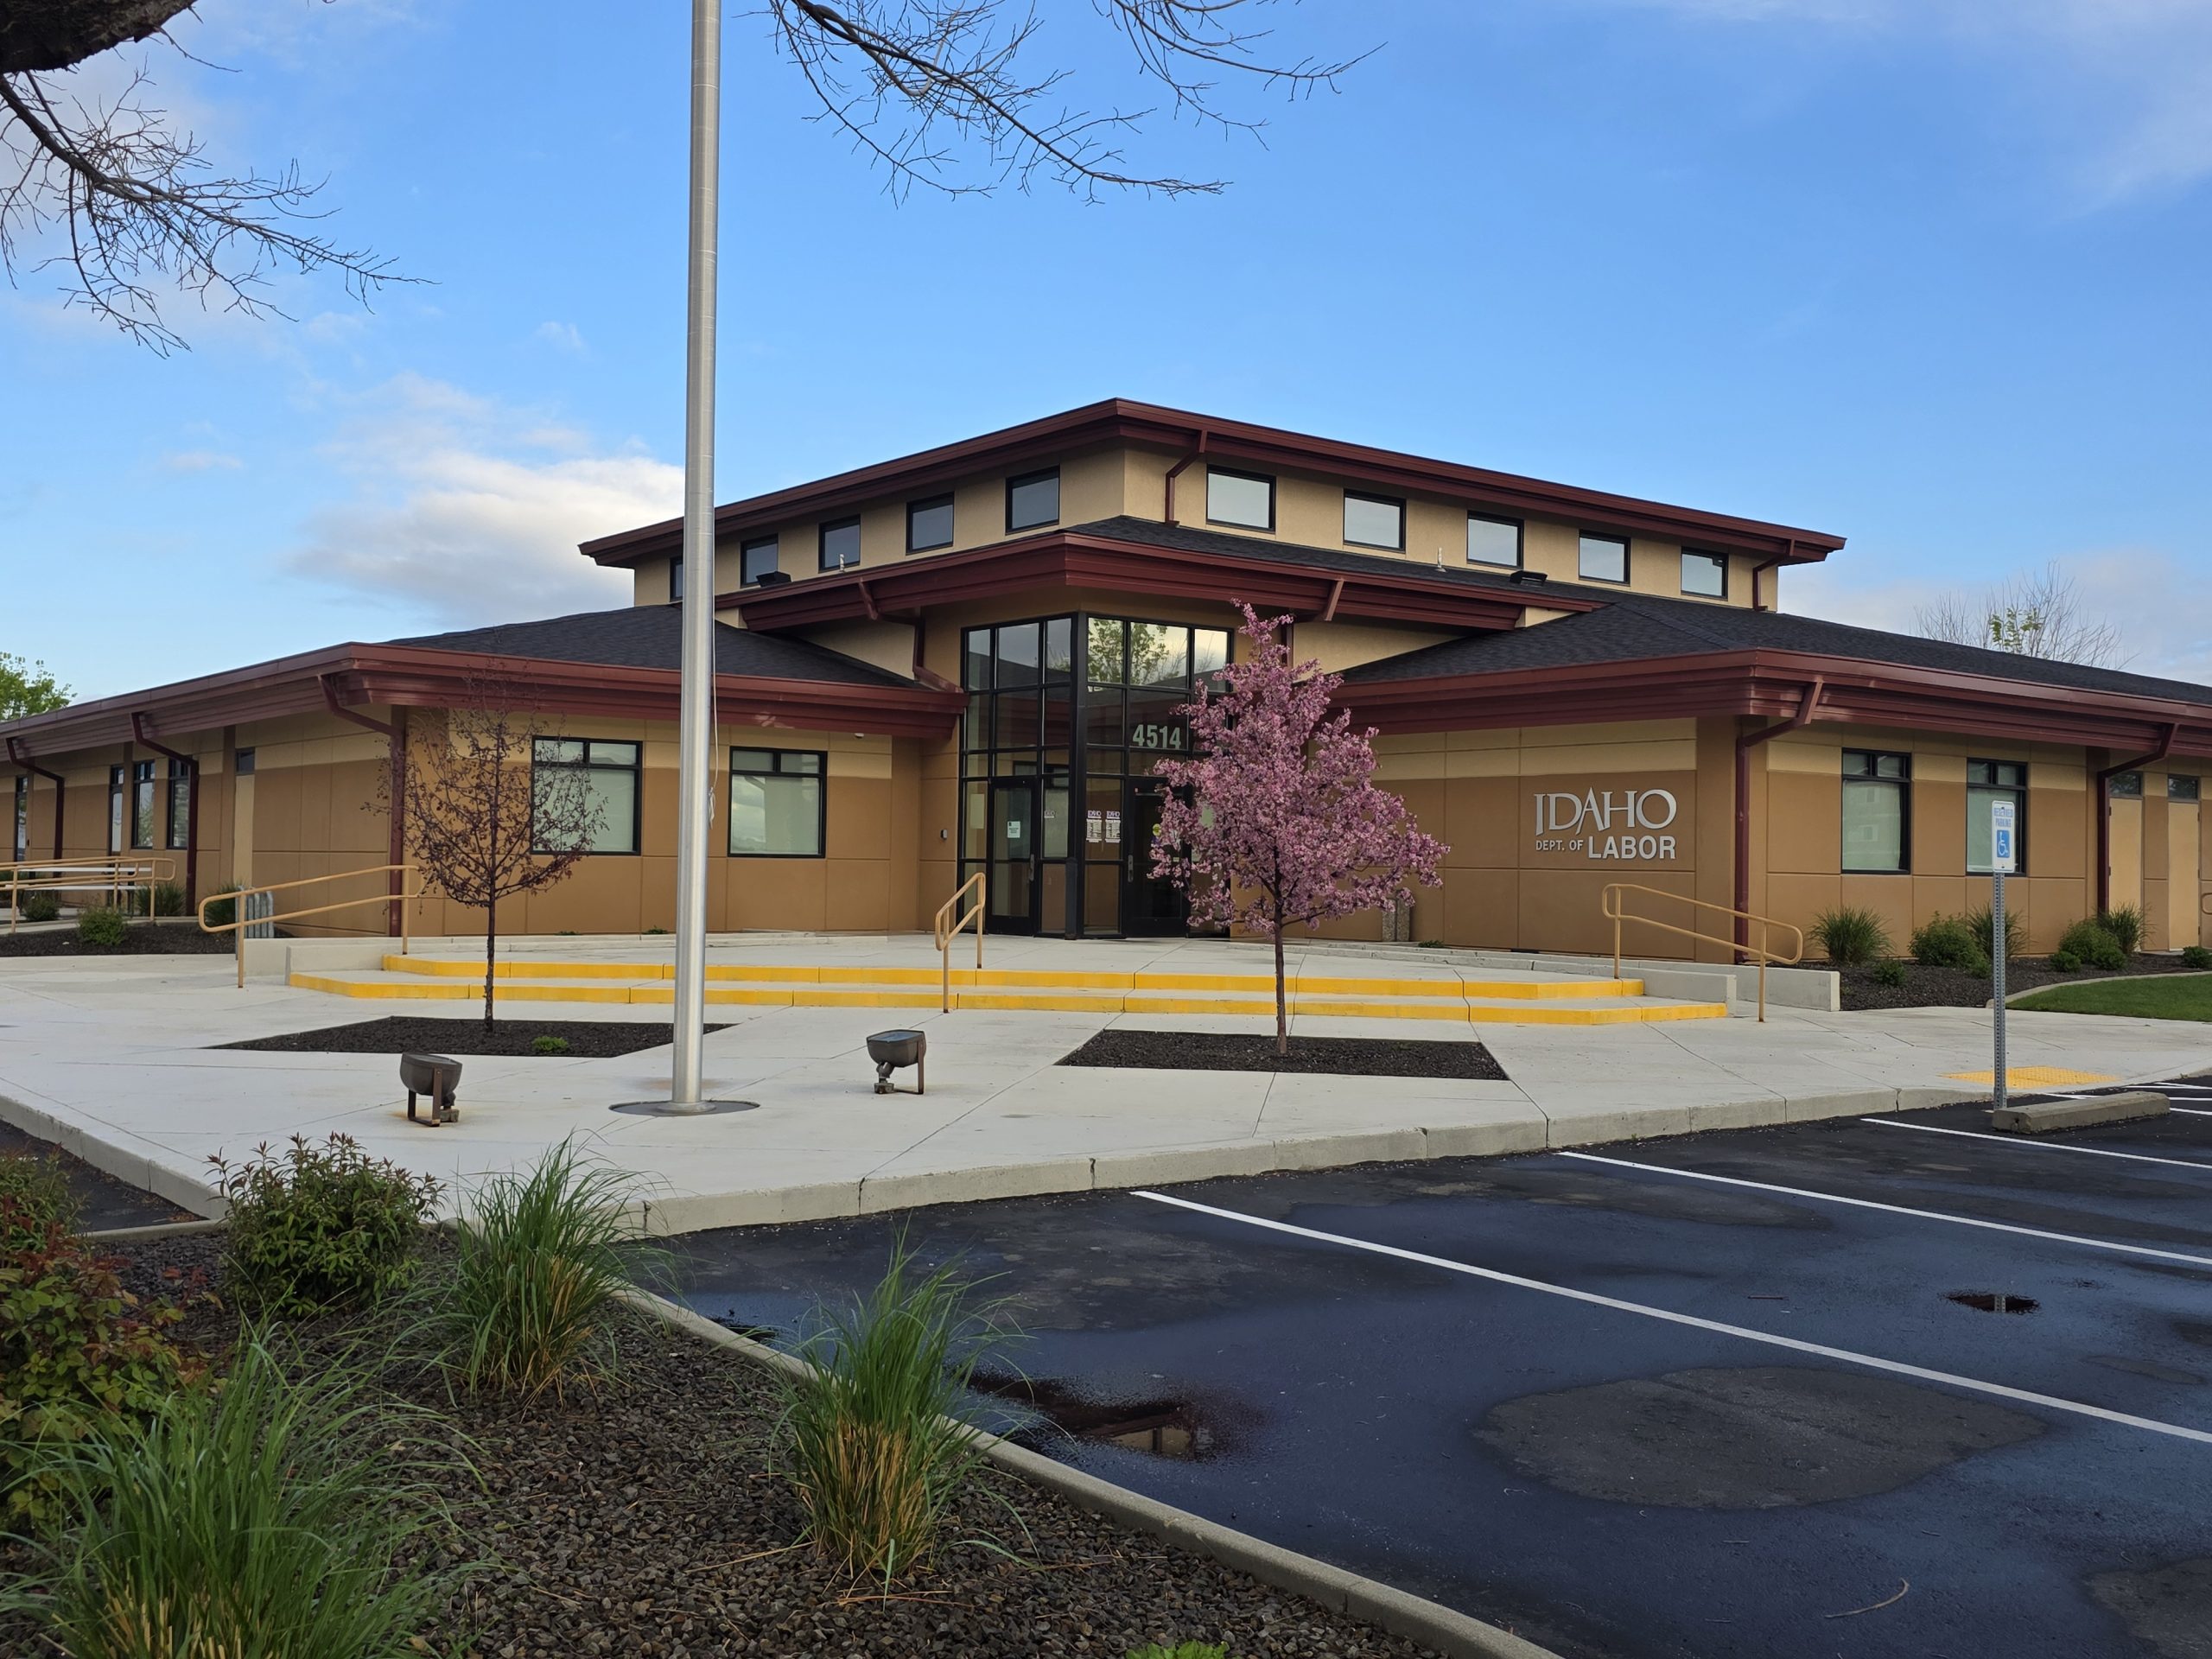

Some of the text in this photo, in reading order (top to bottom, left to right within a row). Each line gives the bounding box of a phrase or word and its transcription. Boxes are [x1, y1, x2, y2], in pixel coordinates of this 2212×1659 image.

[1132, 724, 1181, 749] 4514
[1534, 786, 1677, 836] IDAHO
[1535, 835, 1675, 860] DEPT. OF LABOR
